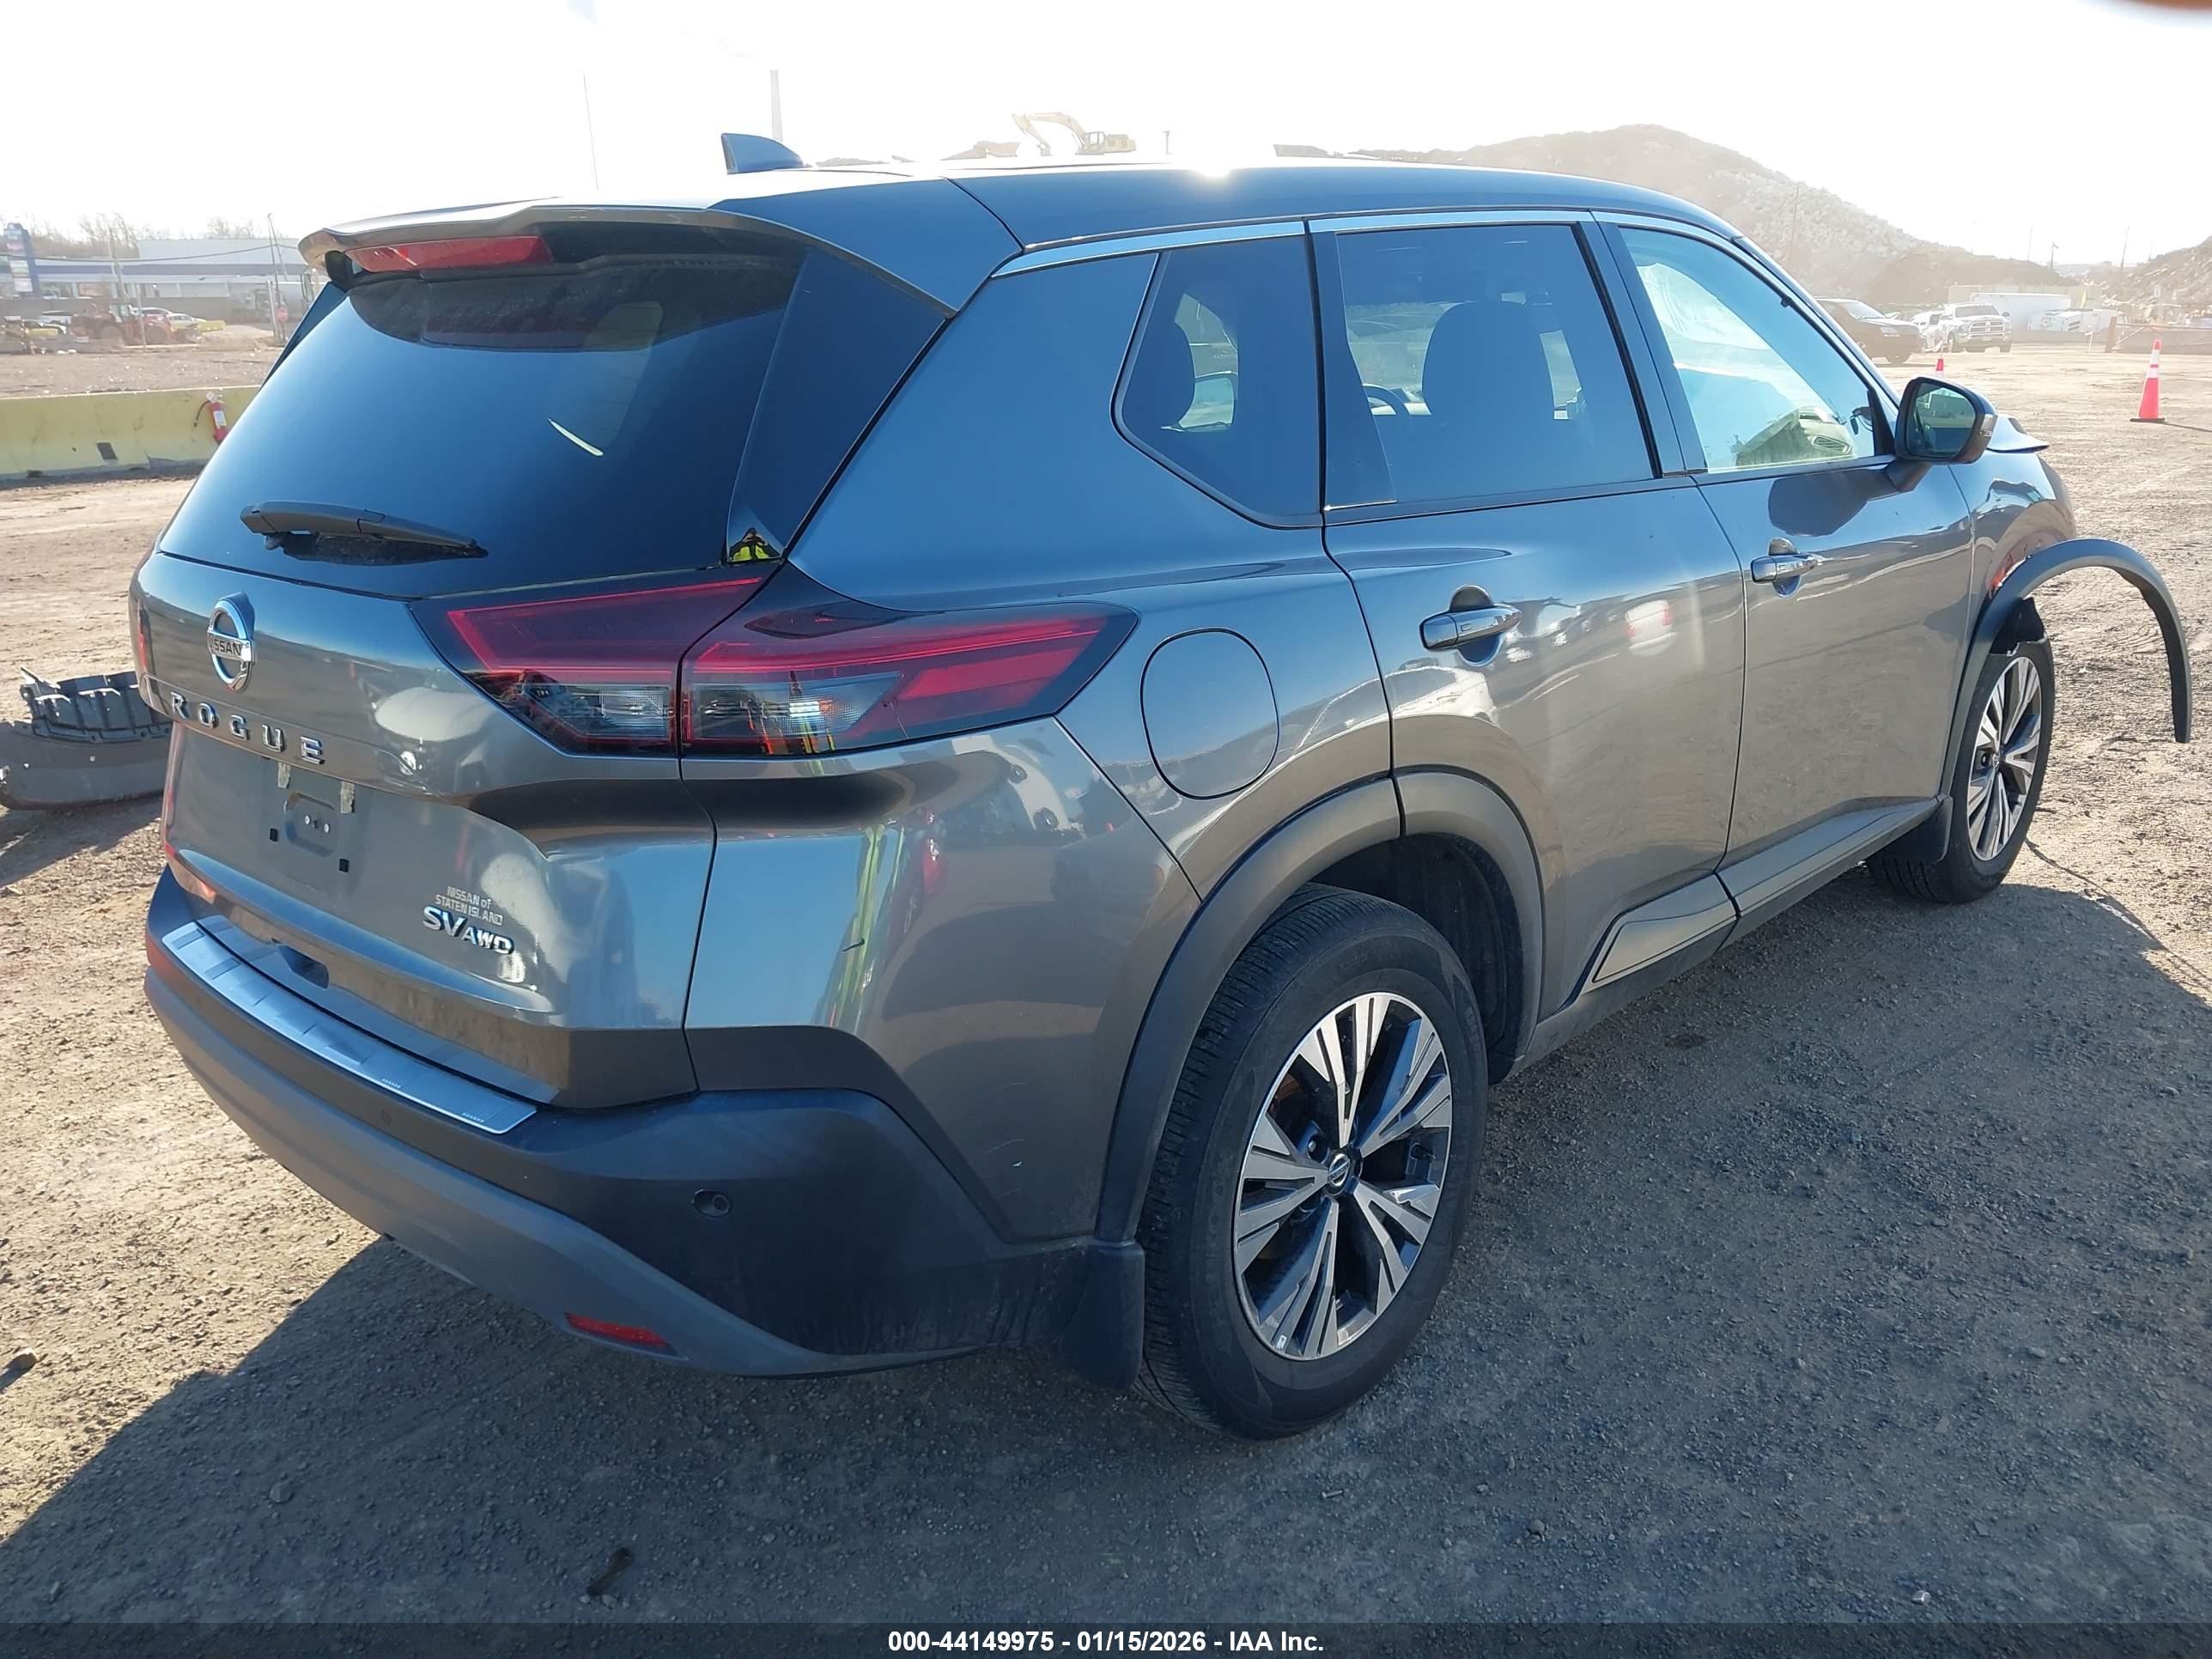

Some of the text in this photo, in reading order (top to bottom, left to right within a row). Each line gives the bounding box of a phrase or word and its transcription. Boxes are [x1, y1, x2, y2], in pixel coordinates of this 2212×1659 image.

[171, 691, 324, 764] ROGUE
[435, 894, 503, 926] STATEN ISLAND
[447, 885, 492, 909] NISSAN of
